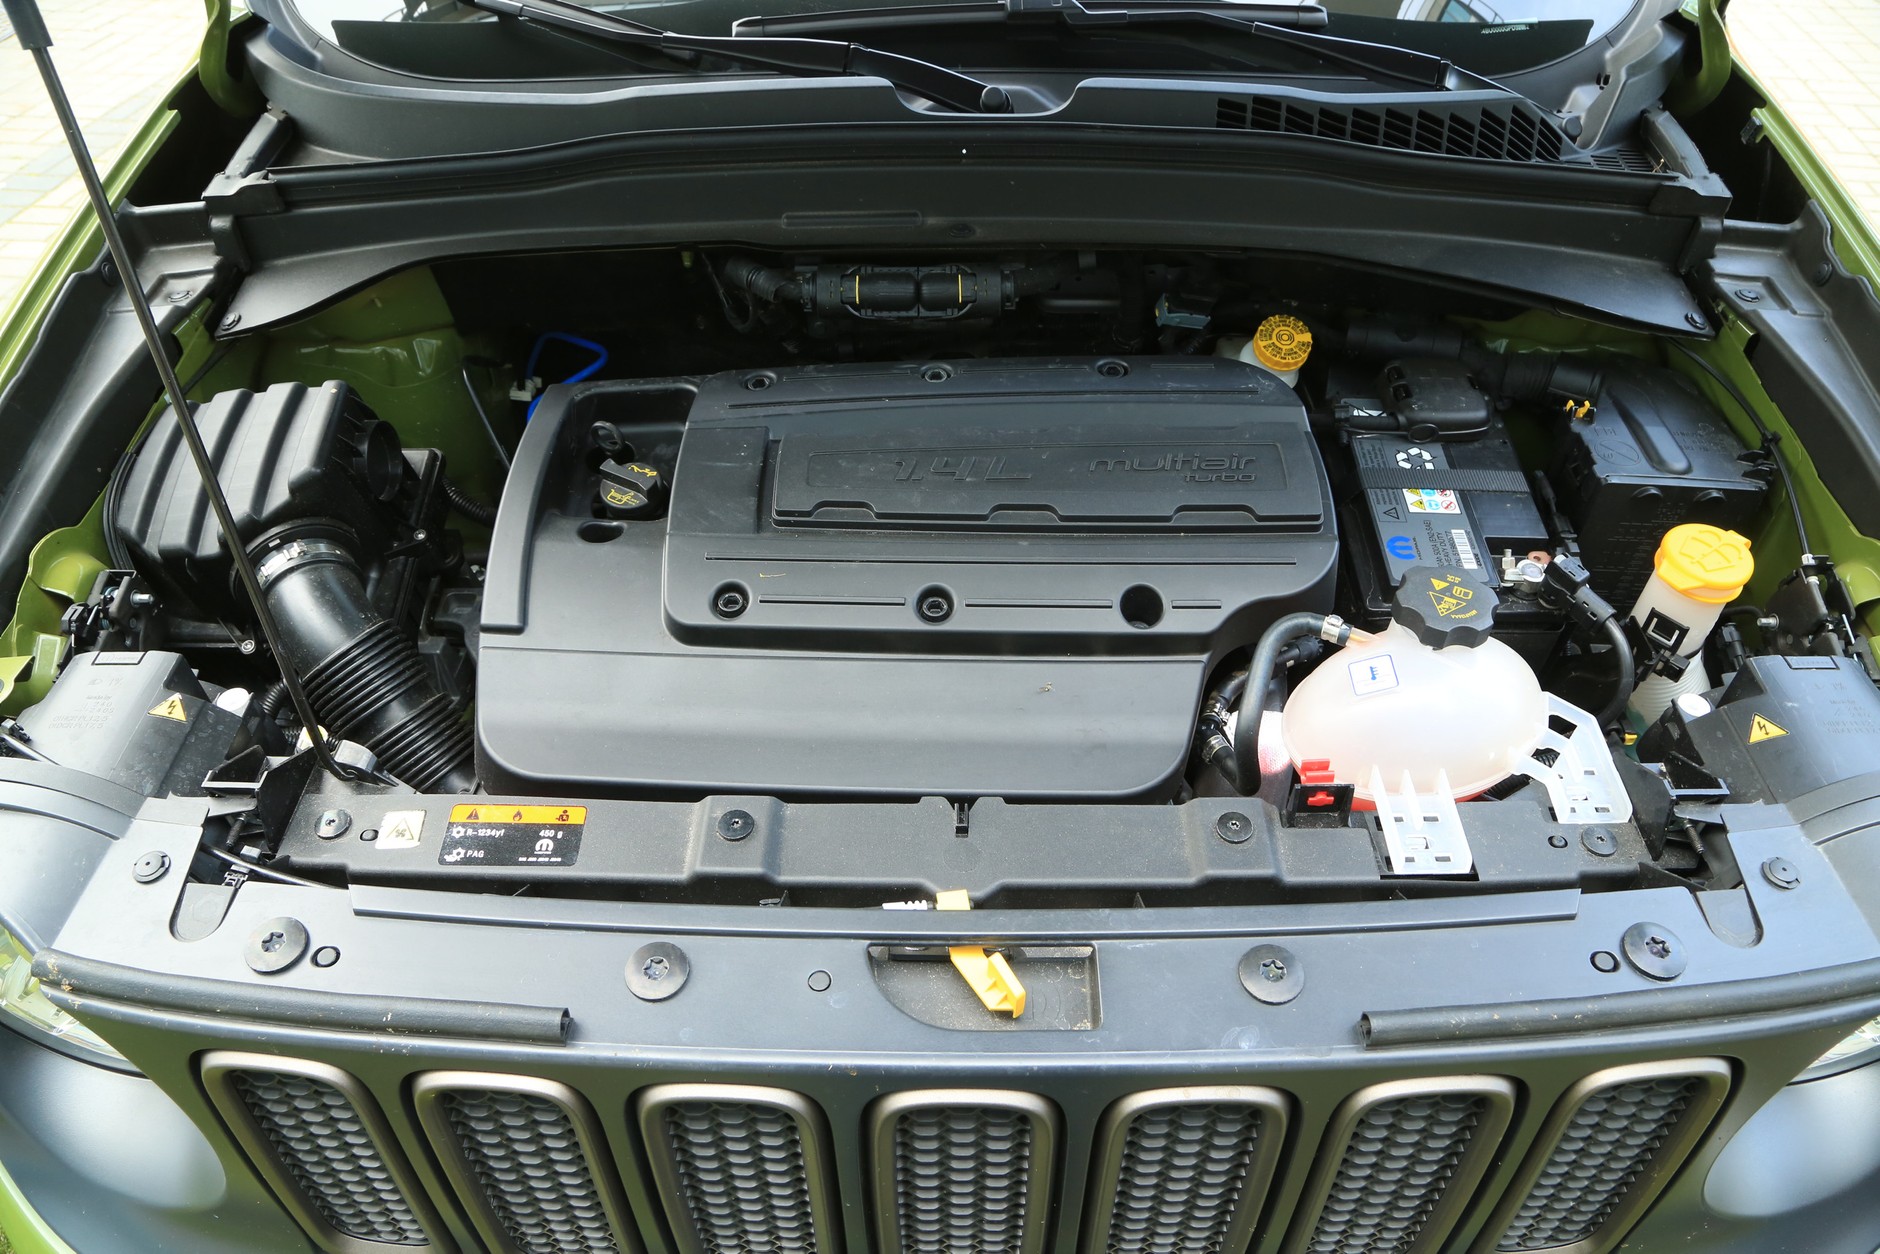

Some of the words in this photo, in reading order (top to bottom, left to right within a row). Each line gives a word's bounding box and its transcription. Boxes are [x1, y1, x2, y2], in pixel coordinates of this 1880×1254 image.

[895, 456, 1032, 481] 1.4L
[1089, 453, 1256, 472] multiair
[1183, 472, 1256, 483] turbo
[1436, 531, 1447, 546] DUTY
[1441, 546, 1453, 566] HEAVY
[466, 828, 505, 838] R-1234yf
[539, 829, 555, 838] 450
[466, 850, 485, 858] PAG
